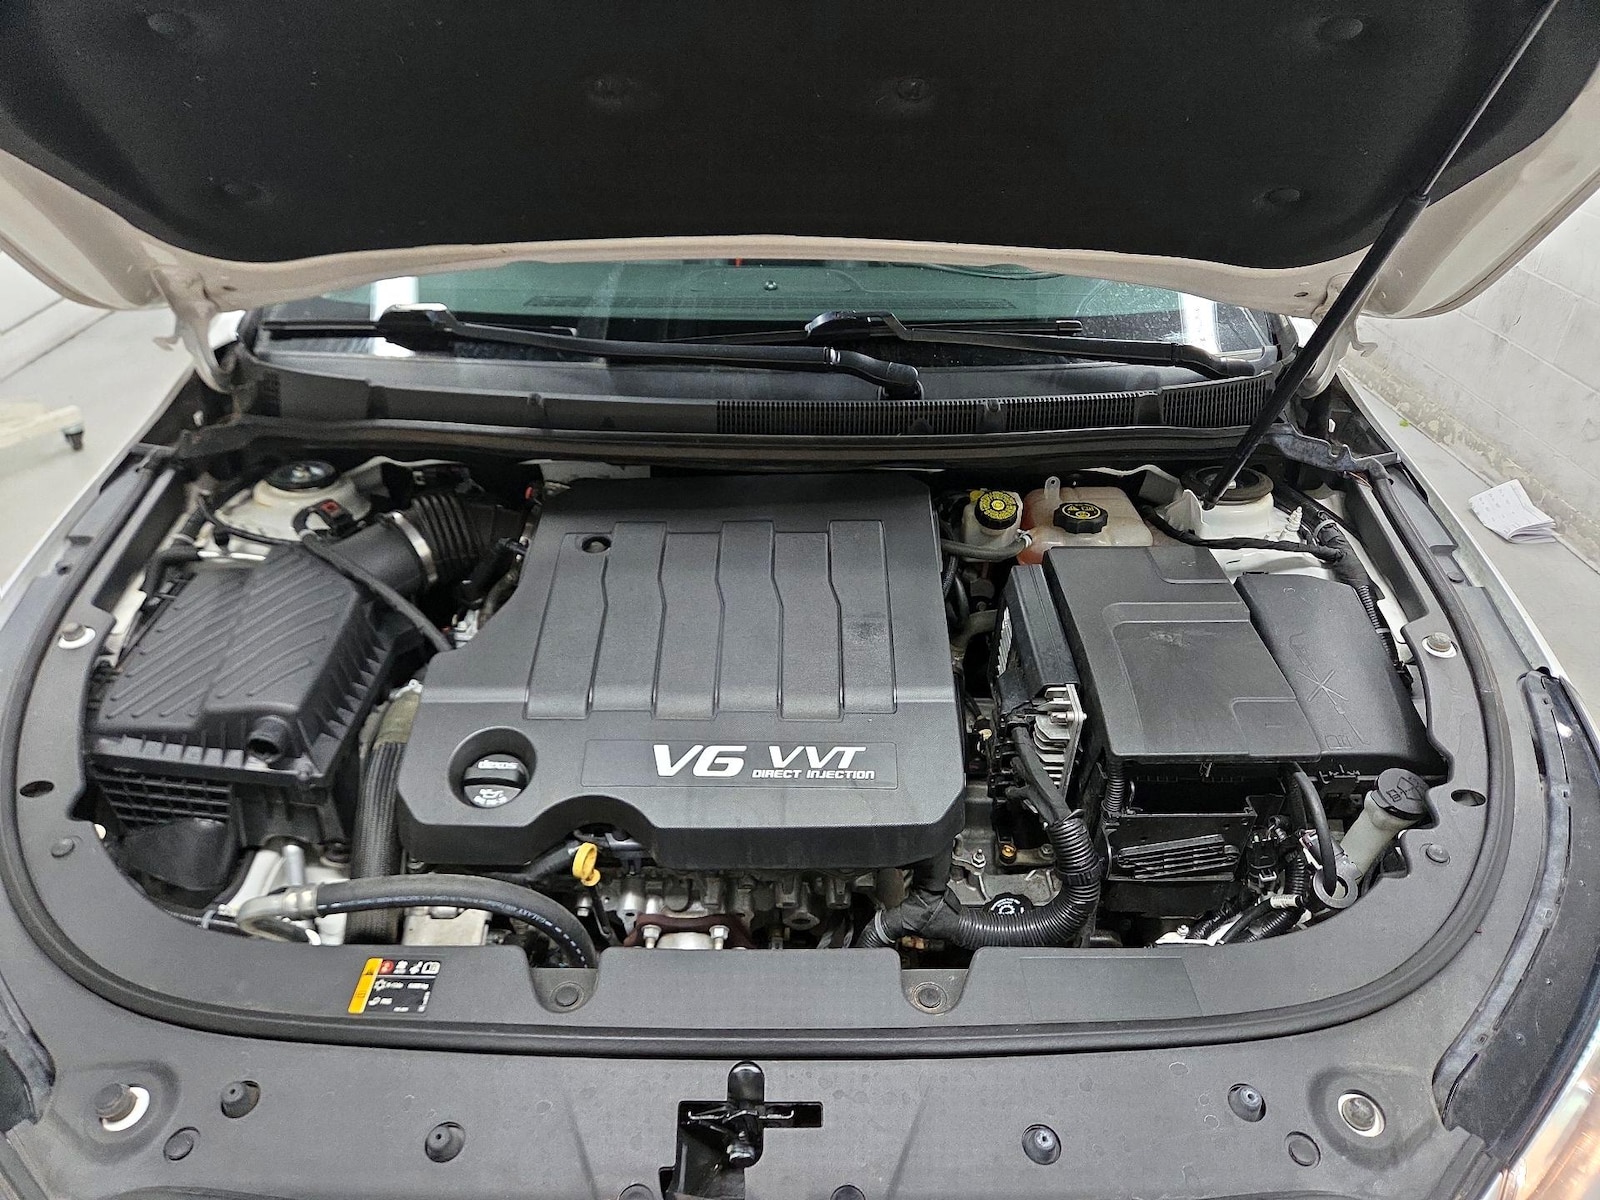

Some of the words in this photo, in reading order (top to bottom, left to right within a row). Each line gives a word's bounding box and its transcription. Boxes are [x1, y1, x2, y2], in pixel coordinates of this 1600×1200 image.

[653, 744, 747, 777] V6
[769, 745, 867, 769] VVT
[752, 769, 802, 779] DIRECT
[806, 769, 875, 780] INJECTION
